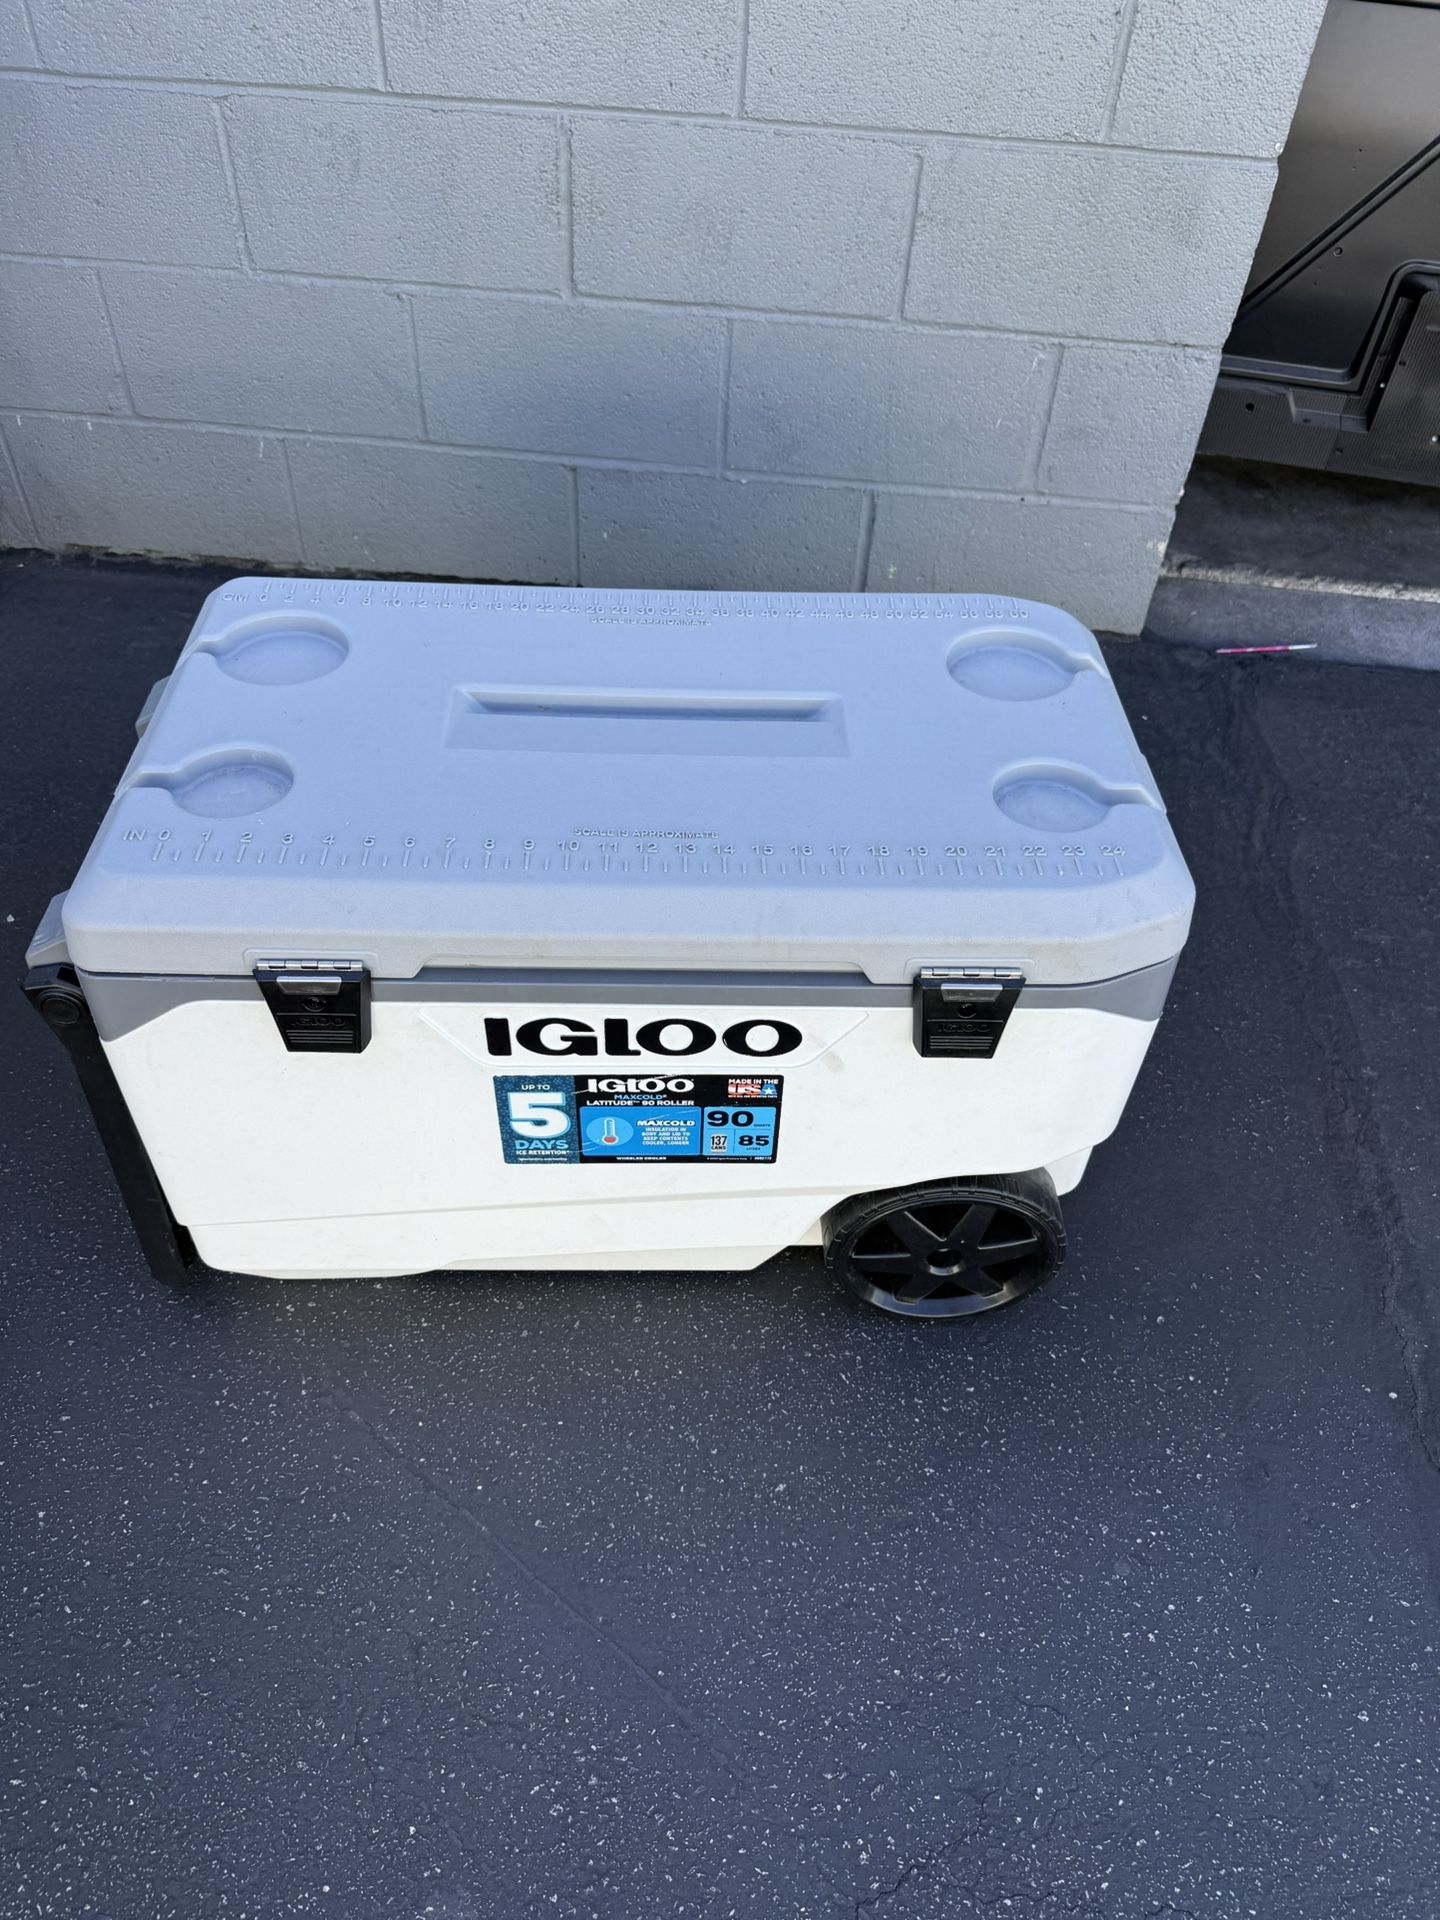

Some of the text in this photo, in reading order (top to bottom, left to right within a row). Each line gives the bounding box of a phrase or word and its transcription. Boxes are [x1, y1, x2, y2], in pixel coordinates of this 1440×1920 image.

[222, 593, 248, 602] CM
[260, 594, 270, 602] 0
[284, 594, 295, 604] 2
[310, 596, 321, 605] 4
[384, 598, 401, 608] 10
[410, 600, 428, 608] 12
[435, 600, 453, 609] 14
[460, 601, 478, 610] 16
[486, 602, 504, 611] 18
[511, 602, 529, 611] 20
[536, 603, 554, 612] 22
[561, 604, 579, 612] 24
[611, 605, 630, 614] 28
[636, 606, 655, 615] 30
[662, 606, 680, 616] 32
[686, 608, 705, 616] 34
[761, 609, 779, 618] 40
[786, 610, 805, 618] 42
[810, 610, 830, 618] 44
[836, 610, 855, 618] 46
[861, 610, 879, 618] 48
[885, 610, 904, 618] 50
[910, 610, 929, 618] 52
[935, 610, 954, 618] 54
[960, 610, 979, 618] 56
[1009, 610, 1029, 618] 60
[639, 618, 712, 626] APPROXIMATE
[574, 828, 720, 840] SCALE IS APPROXIMATE
[123, 829, 1126, 857] IN 0 1 2 3 4 5 6 7 8 9 10 11 12 13 14 15 16 17 18 19 20 21 22 23 24
[484, 1018, 803, 1057] IGLOO
[728, 1084, 778, 1096] USA
[508, 1092, 572, 1139] 5
[706, 1110, 754, 1128] 90
[514, 1140, 569, 1150] DAYS
[710, 1136, 728, 1145] 137
[738, 1134, 770, 1146] 85
